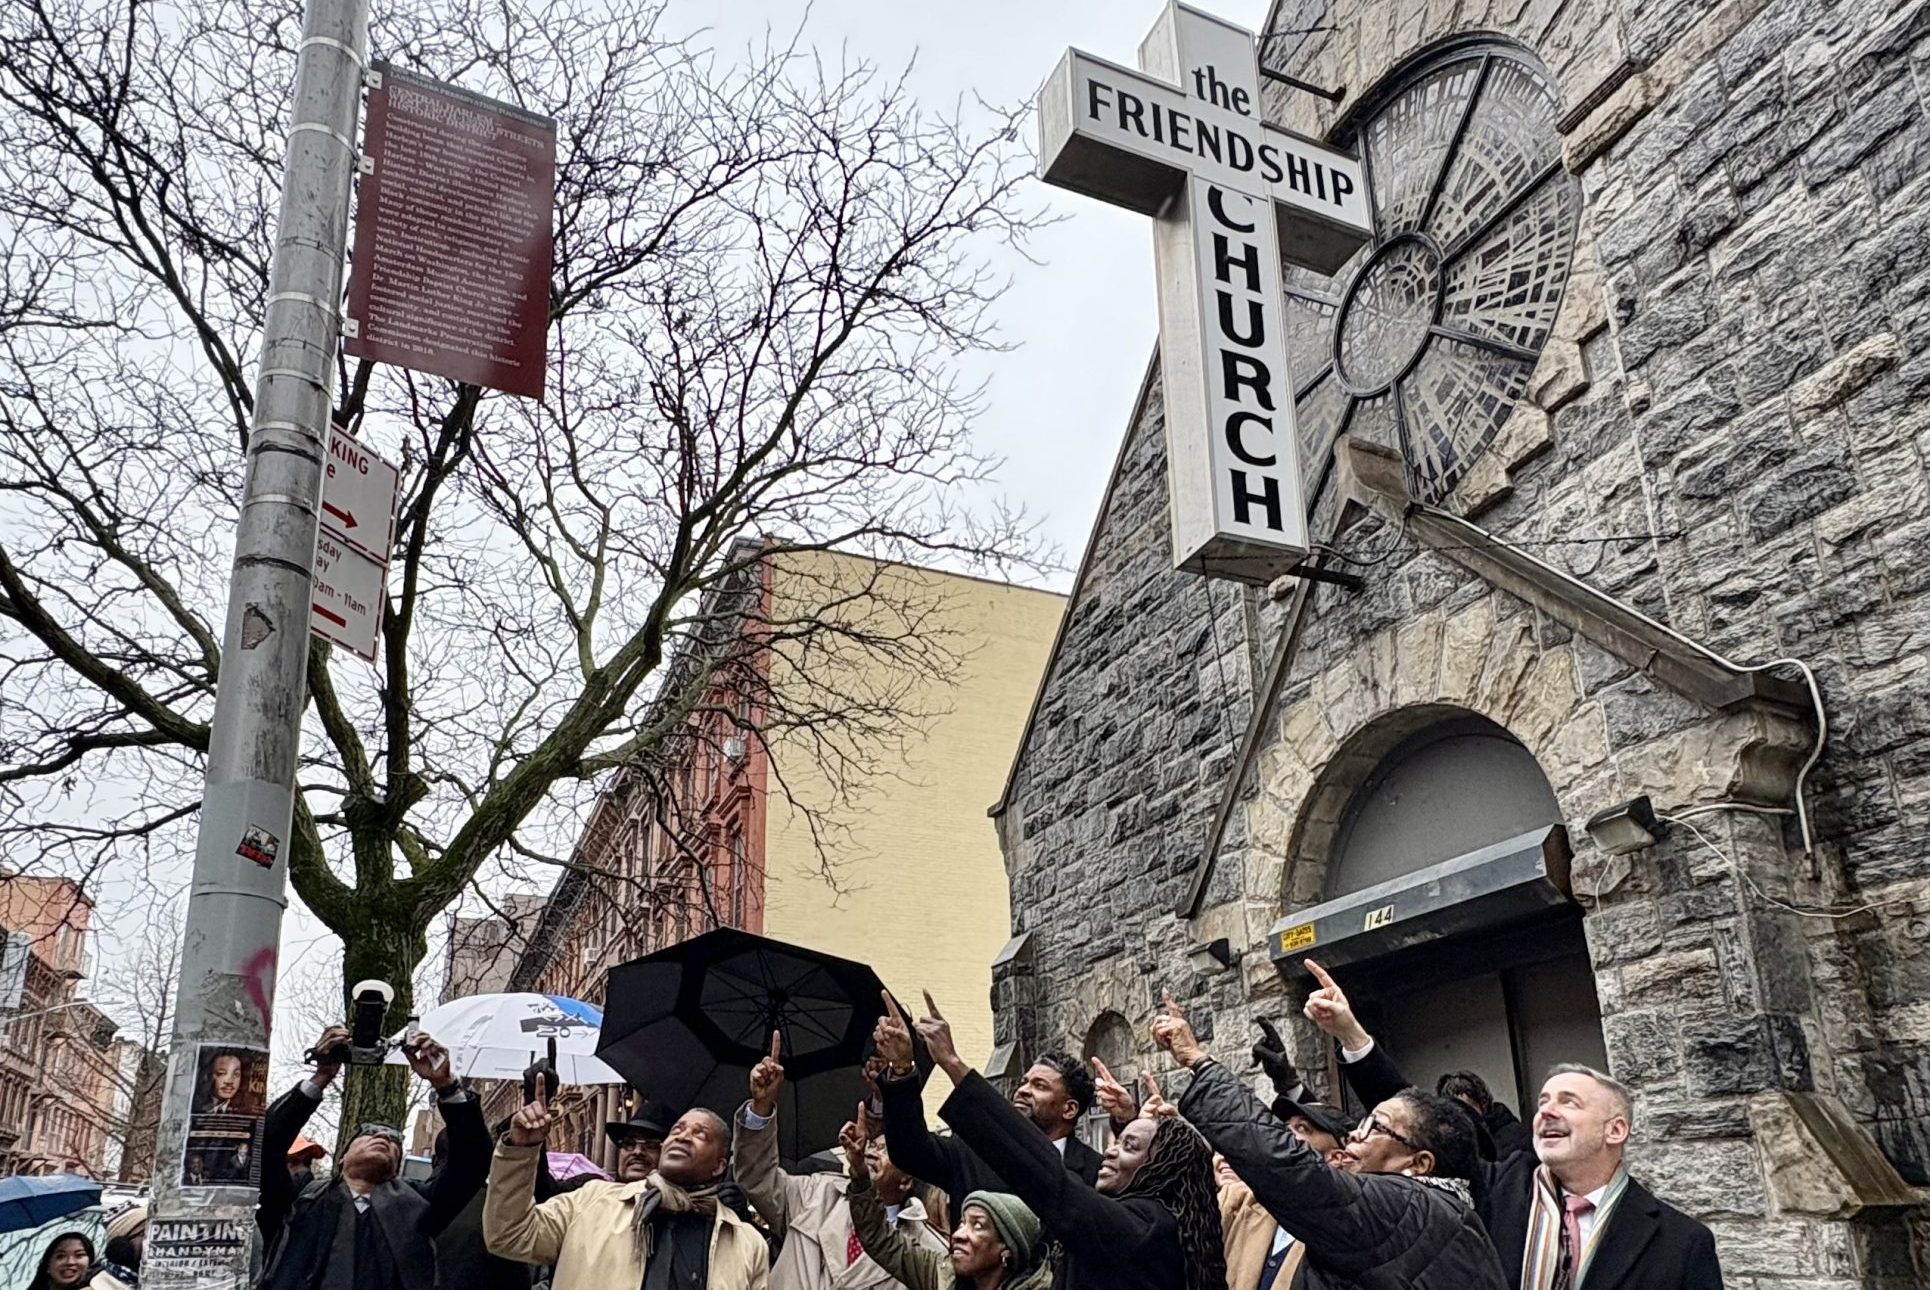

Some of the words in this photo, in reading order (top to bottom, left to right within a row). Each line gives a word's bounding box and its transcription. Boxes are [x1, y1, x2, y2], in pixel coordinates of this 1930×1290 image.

[1191, 65, 1251, 116] the
[386, 130, 422, 146] Harlem's
[443, 148, 464, 160] house
[387, 112, 436, 132] Constructed
[439, 129, 465, 143] during
[468, 139, 480, 147] the
[483, 145, 526, 161] speculative
[387, 121, 418, 137] building
[423, 133, 442, 144] boom
[447, 141, 462, 150] that
[465, 148, 493, 160] created
[497, 156, 525, 170] Central
[1087, 78, 1354, 206] FRIENDSHIP
[384, 148, 414, 163] Harlem
[426, 161, 444, 172] West
[500, 185, 527, 198] Streets
[385, 140, 397, 148] the
[401, 144, 415, 154] late
[475, 168, 487, 176] the
[491, 172, 519, 186] Central
[382, 169, 435, 188] architectural
[439, 184, 488, 204] development
[492, 202, 505, 210] and
[509, 206, 520, 214] the
[384, 158, 415, 173] Historic
[419, 169, 449, 183] District
[496, 193, 530, 208] Harlem's
[380, 195, 402, 208] Many
[416, 207, 437, 217] these
[441, 215, 483, 231] residential
[487, 227, 522, 242] buildings
[381, 186, 403, 198] Black
[406, 195, 451, 213] community
[466, 212, 478, 220] the
[447, 198, 462, 206] and
[465, 204, 496, 216] political
[500, 212, 511, 220] life
[378, 216, 406, 229] variety
[501, 252, 528, 263] artistic
[379, 207, 398, 216] were
[401, 213, 434, 226] adapted
[448, 227, 501, 246] accommodate
[374, 253, 422, 271] Amsterdam
[426, 267, 458, 281] Musical
[375, 243, 402, 256] March
[473, 271, 485, 279] the
[488, 275, 504, 284] New
[376, 233, 412, 249] National
[416, 245, 472, 266] Headquarters
[475, 261, 485, 269] for
[489, 266, 501, 274] the
[505, 270, 522, 280] 1963
[401, 231, 449, 250] Institutions
[460, 248, 496, 264] including
[371, 282, 405, 297] fostered
[408, 294, 432, 304] social
[374, 263, 419, 282] Friendship
[423, 276, 453, 289] Baptist
[491, 297, 514, 306] where
[389, 277, 418, 290] Martin
[422, 286, 450, 299] Luther
[453, 294, 472, 306] King
[489, 306, 511, 315] spoke
[367, 332, 398, 346] district
[369, 304, 403, 316] cultural
[407, 314, 456, 330] significance
[469, 328, 482, 336] the
[369, 312, 385, 321] The
[388, 317, 437, 335] Landmarks
[440, 330, 492, 349] Preservation
[442, 313, 484, 327] contribute
[498, 326, 509, 334] the
[368, 322, 420, 341] Commission
[423, 336, 468, 353] designated
[472, 349, 487, 358] this
[490, 353, 519, 366] historic
[1207, 185, 1285, 532] CHURCH
[331, 436, 368, 475] KING
[318, 539, 341, 562] sday
[344, 593, 366, 616] 11am
[1368, 906, 1392, 929] 144
[248, 1079, 265, 1094] KIN
